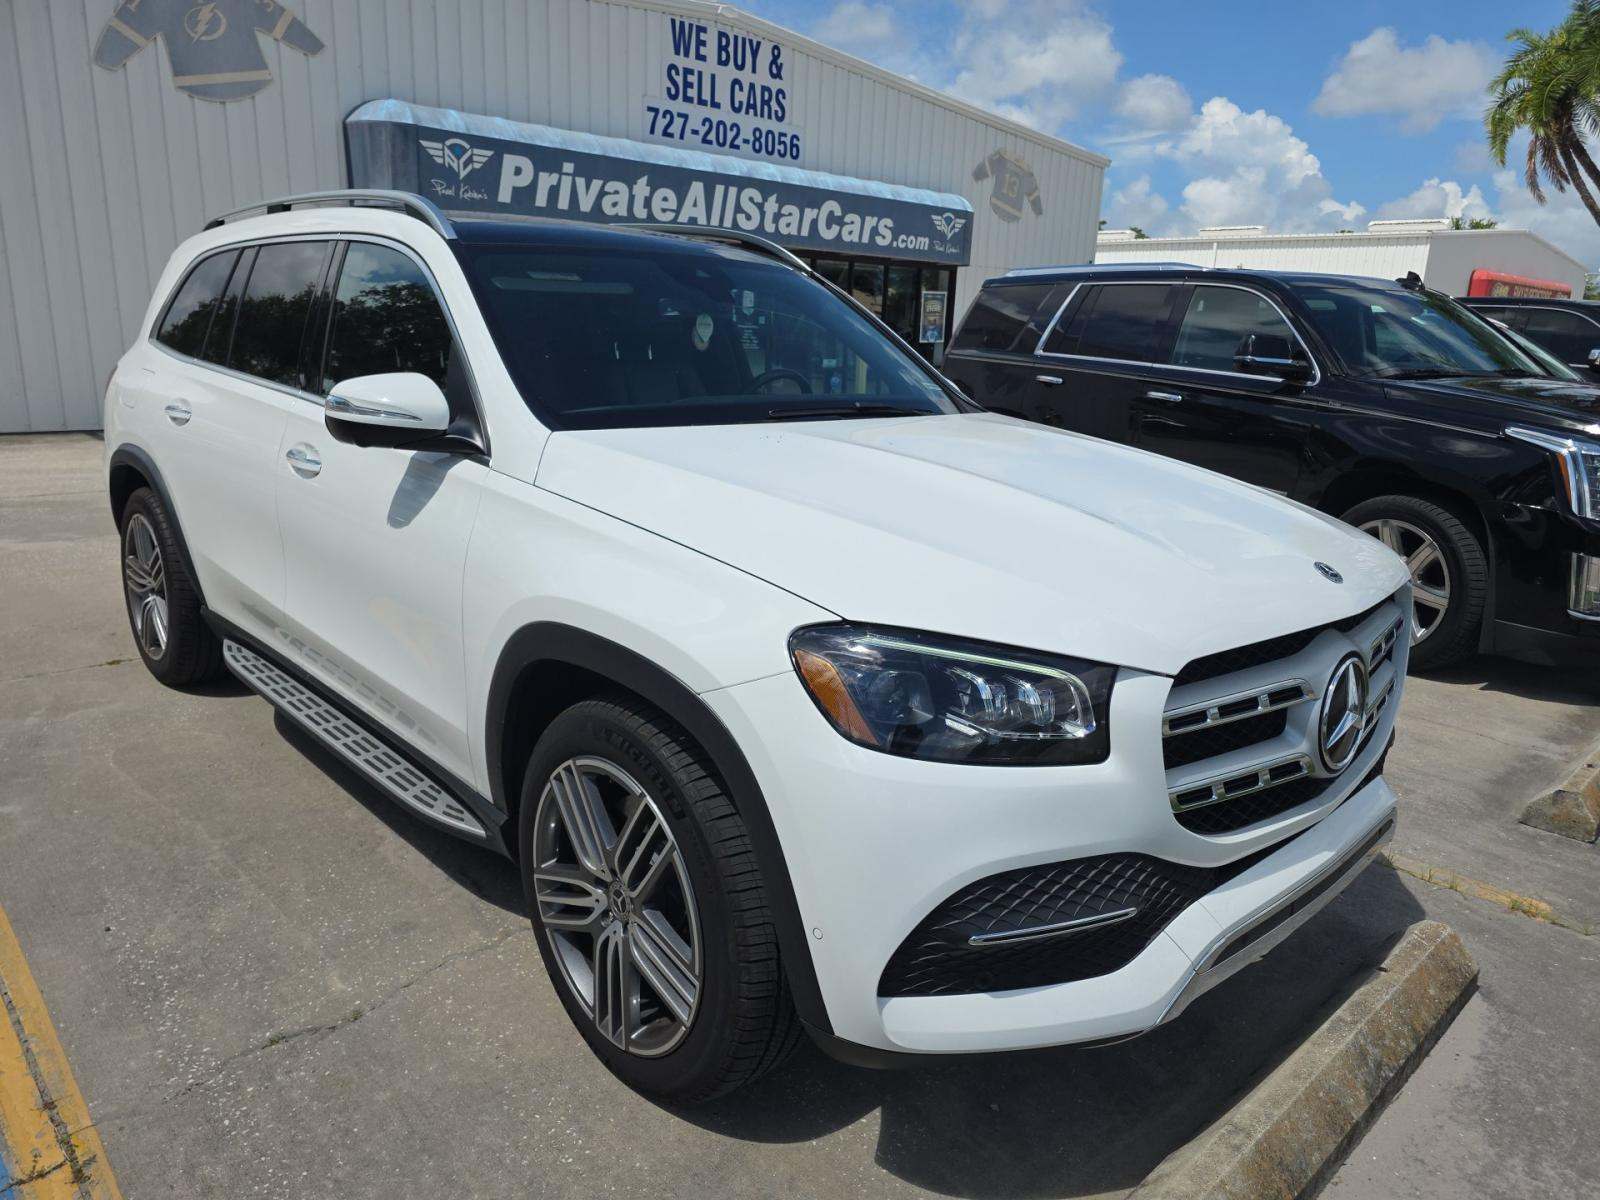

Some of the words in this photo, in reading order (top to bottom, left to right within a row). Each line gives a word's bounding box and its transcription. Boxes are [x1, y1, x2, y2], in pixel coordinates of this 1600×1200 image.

[671, 18, 708, 62] WE
[717, 30, 761, 74] BUY
[769, 45, 783, 80] &
[666, 63, 721, 109] SELL
[730, 78, 786, 122] CARS
[646, 106, 800, 160] 727-202-8056
